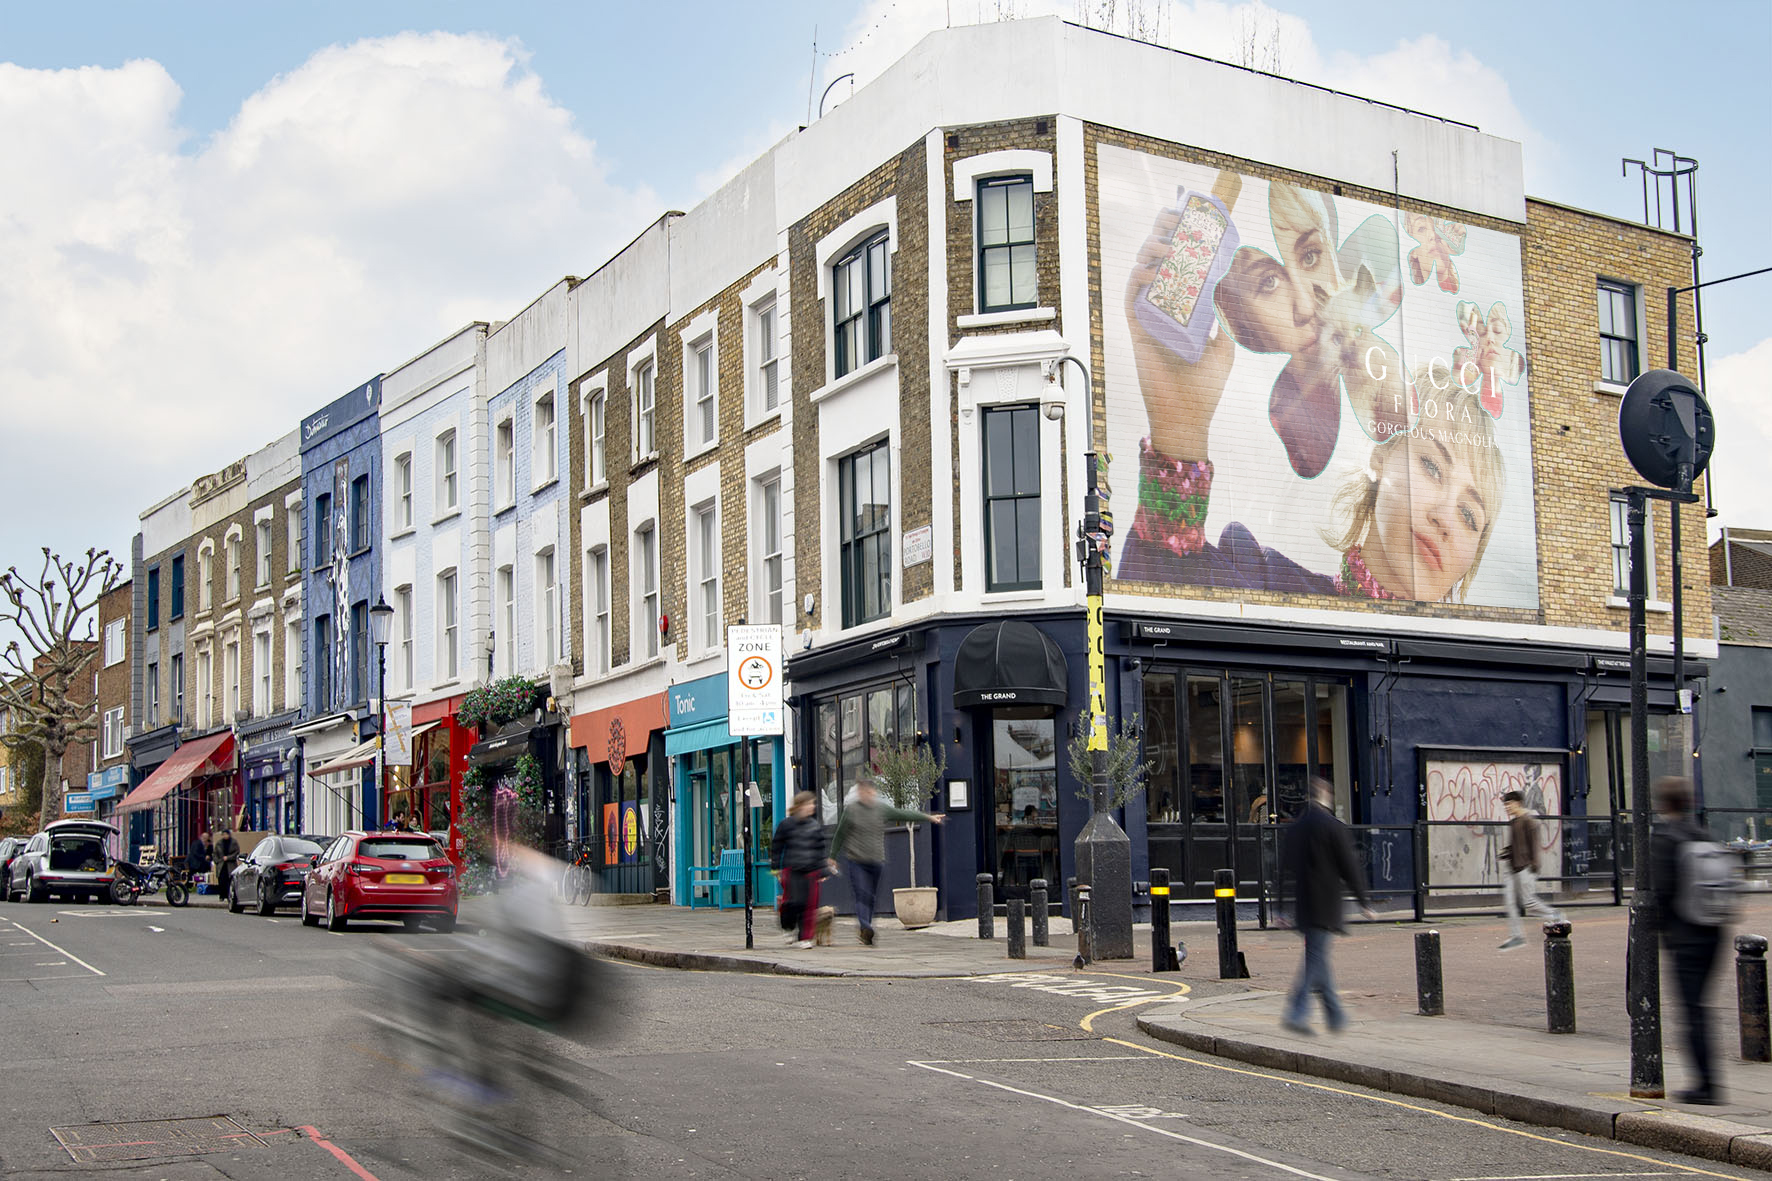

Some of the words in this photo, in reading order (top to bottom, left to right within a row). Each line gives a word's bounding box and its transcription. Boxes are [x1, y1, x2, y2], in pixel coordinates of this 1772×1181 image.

[1365, 345, 1496, 398] GUCCI
[1394, 394, 1472, 424] FLORA
[1367, 420, 1435, 441] GORGEOUS
[1438, 429, 1499, 448] MAGNOLIA
[738, 643, 771, 652] ZONE
[675, 693, 696, 715] Tonic
[993, 692, 1016, 700] GRAND
